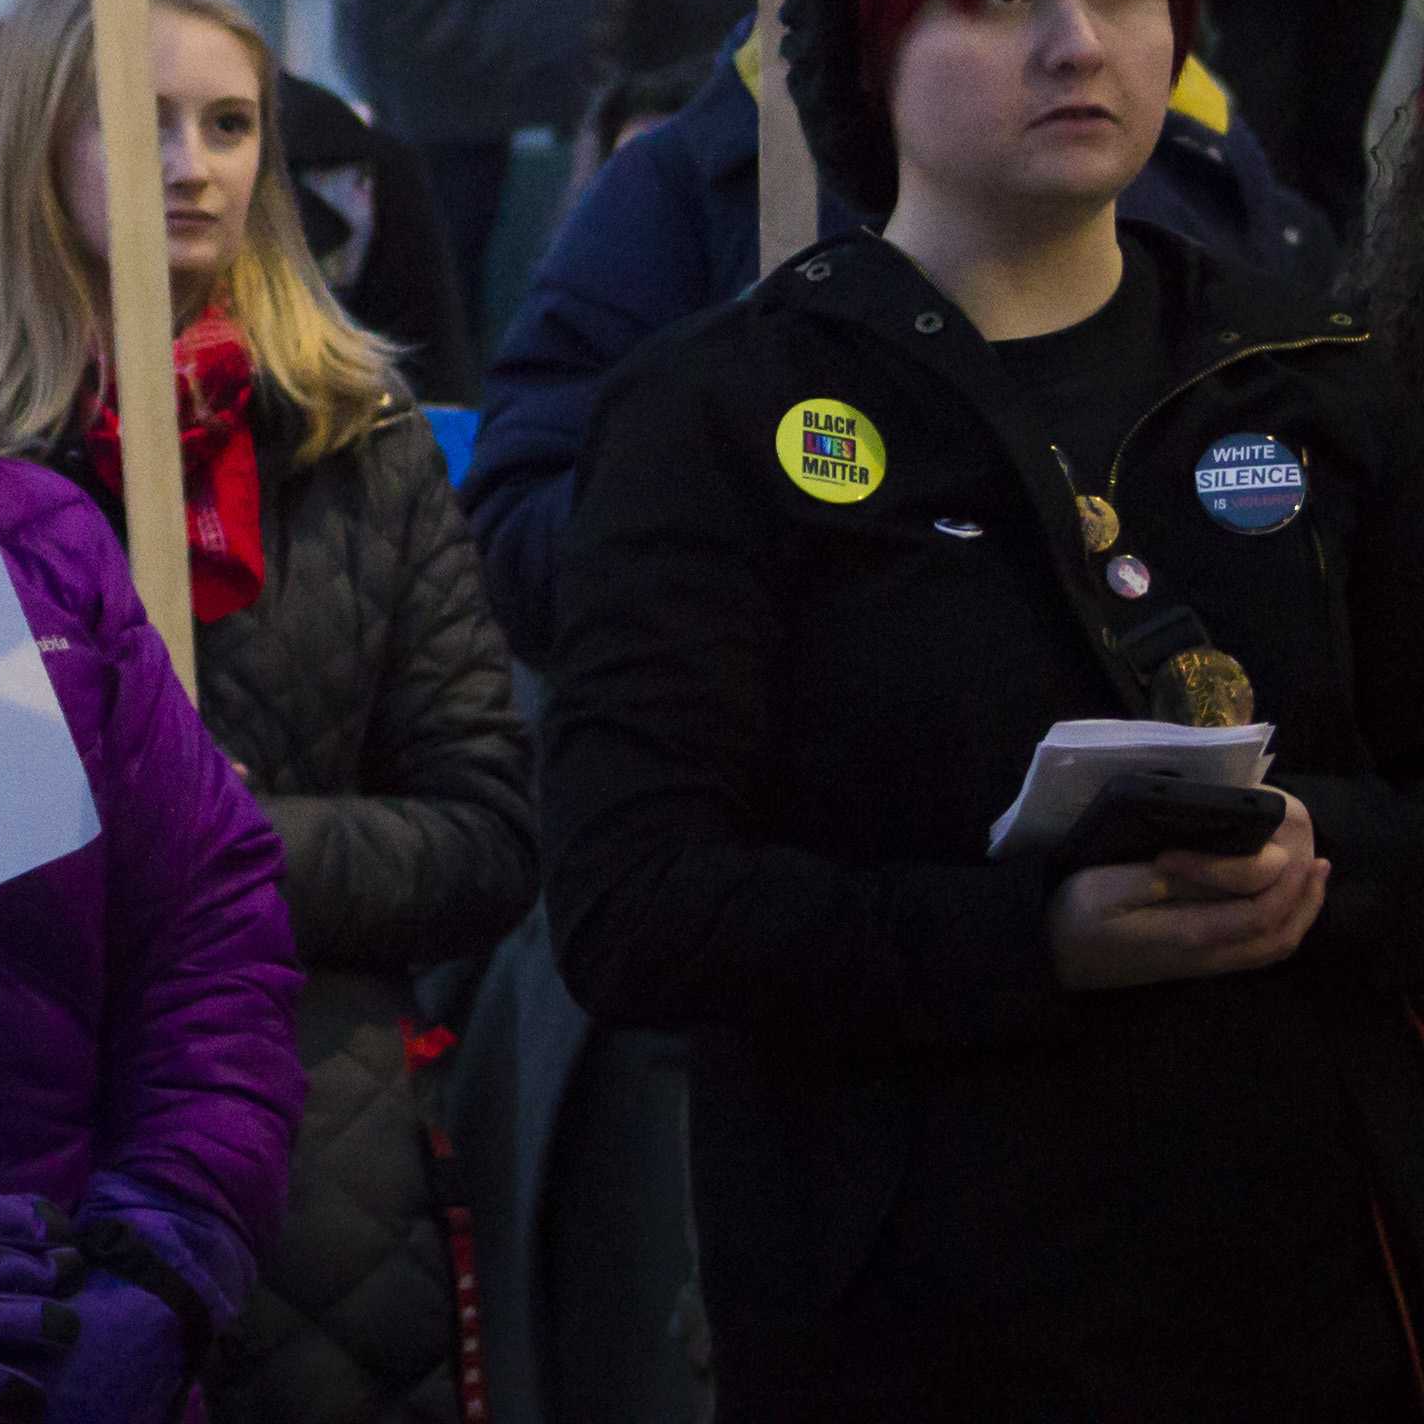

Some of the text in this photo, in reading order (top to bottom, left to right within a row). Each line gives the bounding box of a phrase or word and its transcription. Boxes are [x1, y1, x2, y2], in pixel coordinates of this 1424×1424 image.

[803, 410, 856, 436] BLACK
[804, 432, 855, 460] LIVES
[1213, 444, 1275, 463] WHITE
[802, 456, 869, 485] MATTER
[1199, 466, 1298, 489] SILENCE
[1214, 498, 1227, 510] IS
